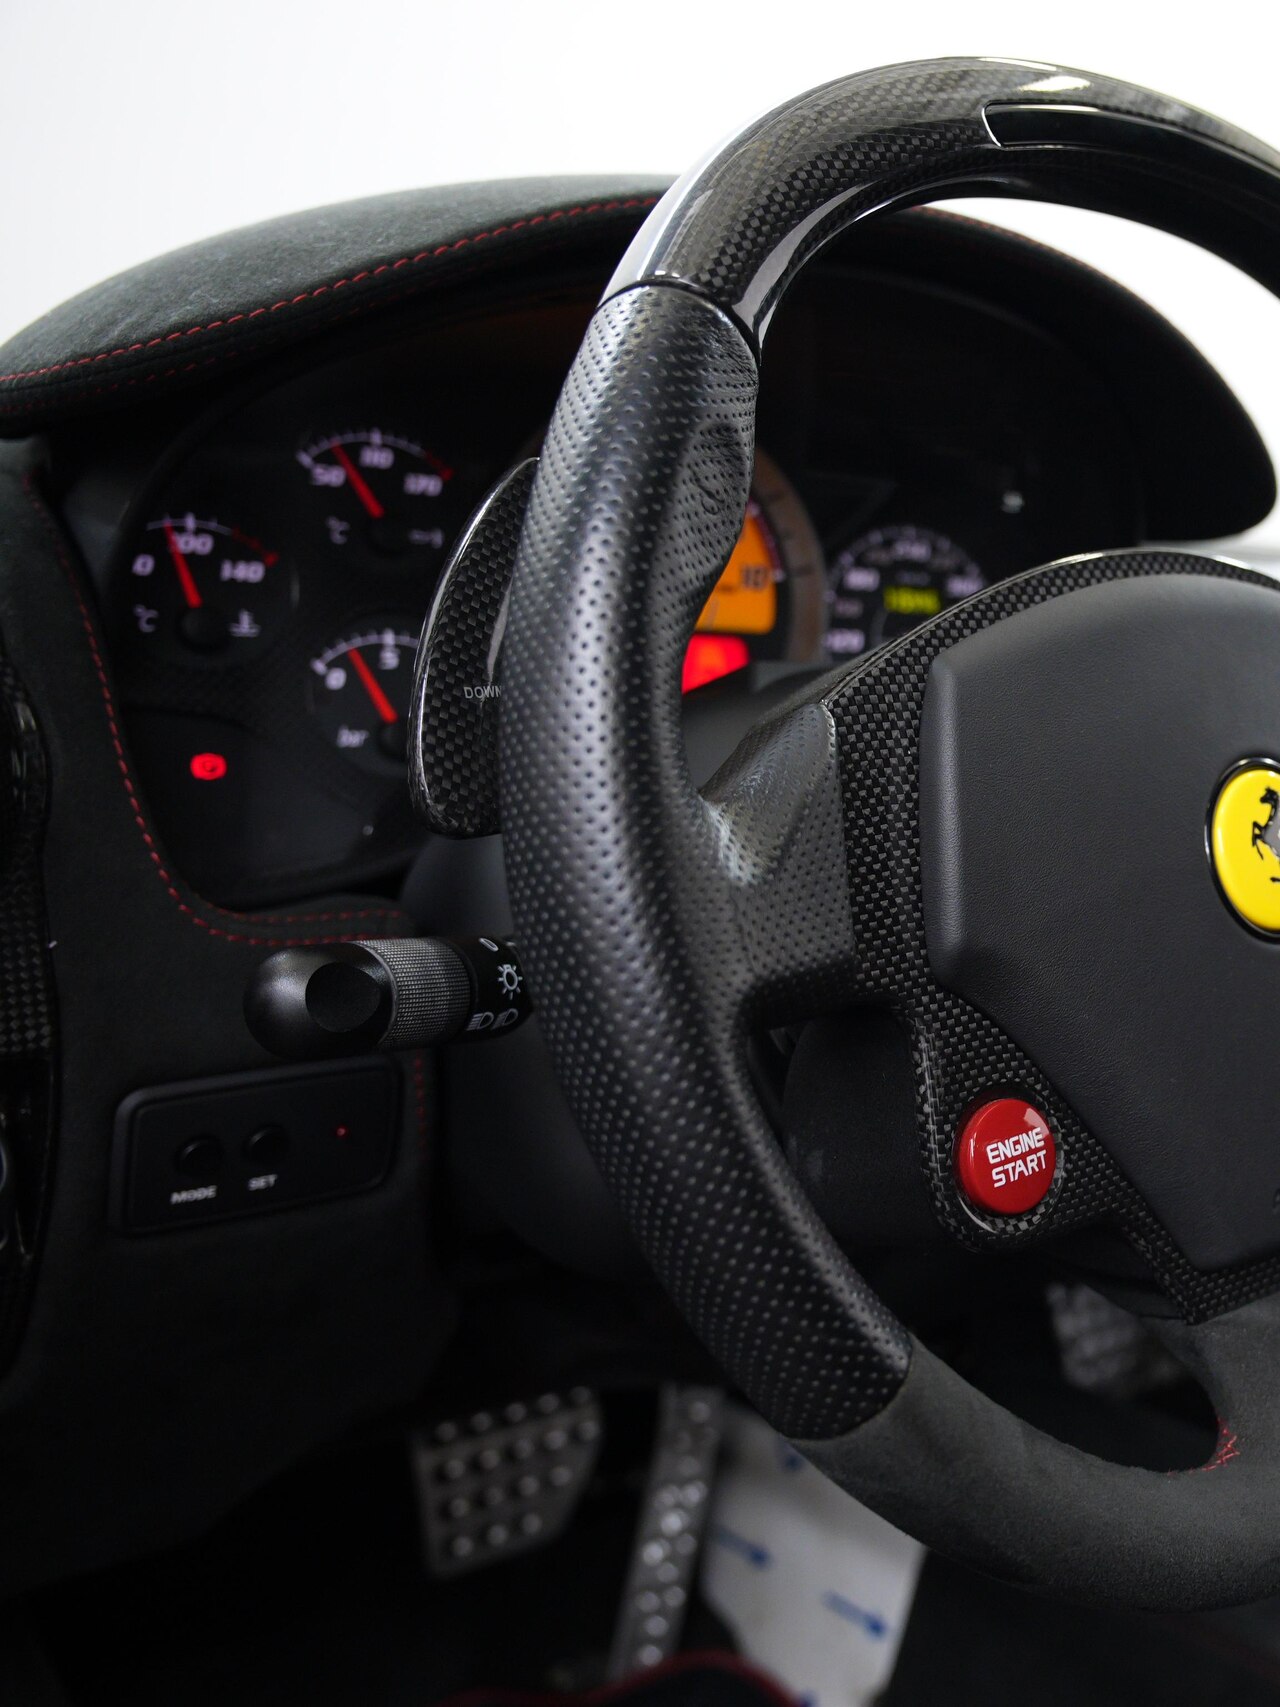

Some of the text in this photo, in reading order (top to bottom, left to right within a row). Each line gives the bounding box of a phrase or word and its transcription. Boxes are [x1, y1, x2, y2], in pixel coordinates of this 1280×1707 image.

[986, 1126, 1045, 1165] ENGINE
[247, 1174, 278, 1191] SET
[991, 1149, 1047, 1188] START
[170, 1185, 217, 1205] MODE
